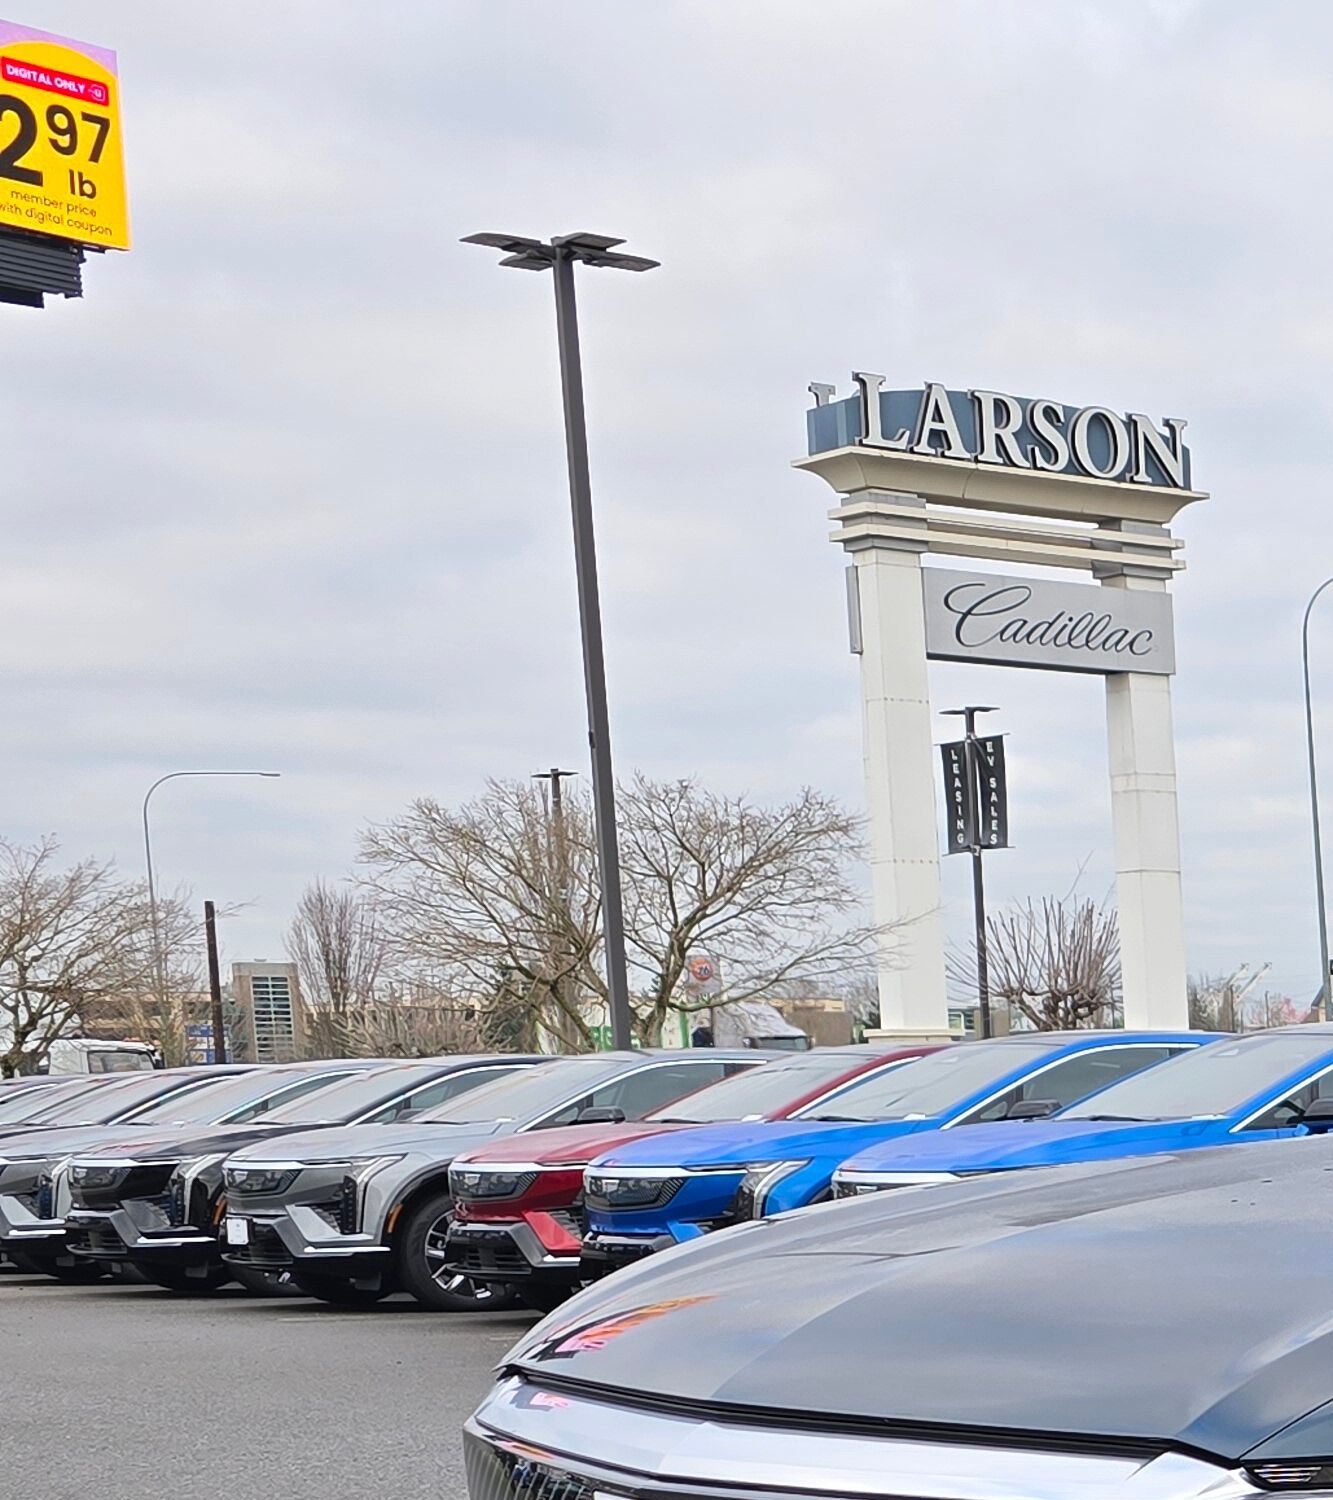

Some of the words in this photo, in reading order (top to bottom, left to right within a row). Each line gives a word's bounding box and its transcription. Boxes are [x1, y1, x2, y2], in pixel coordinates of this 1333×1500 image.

[6, 63, 52, 86] DIGITAL
[54, 77, 86, 94] ONLY
[68, 169, 97, 199] lb
[11, 190, 62, 209] member
[66, 203, 97, 218] price
[25, 207, 65, 225] digital
[66, 219, 113, 236] coupon
[853, 371, 1188, 490] LARSON
[942, 582, 1154, 656] Cadillac
[986, 741, 995, 767] EV
[951, 749, 965, 845] LEASING
[989, 777, 999, 846] SALES
